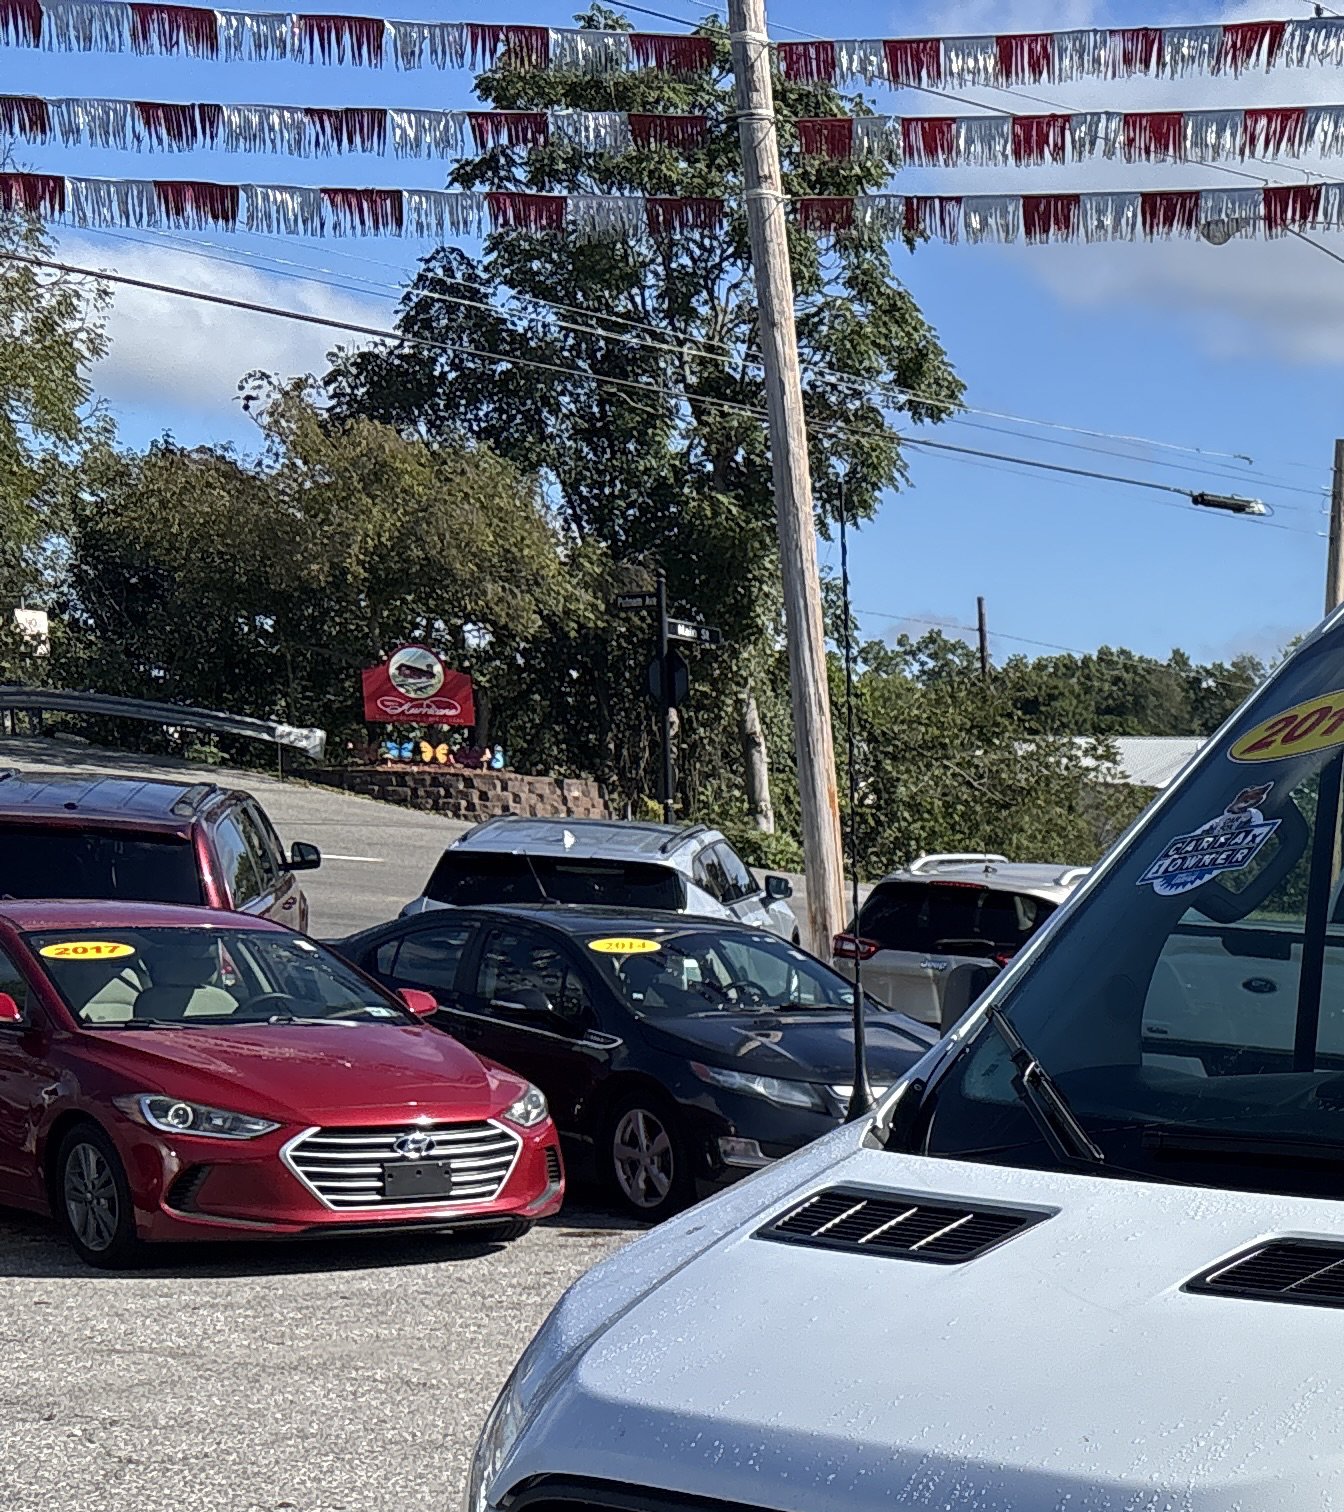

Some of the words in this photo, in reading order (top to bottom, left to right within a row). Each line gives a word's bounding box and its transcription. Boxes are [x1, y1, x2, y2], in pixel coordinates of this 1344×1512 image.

[677, 623, 698, 638] Main
[679, 705, 769, 776] Ford
[1167, 831, 1263, 857] CARFAX
[1168, 849, 1249, 872] OWNER
[54, 945, 120, 956] 2017
[605, 941, 646, 950] 2014
